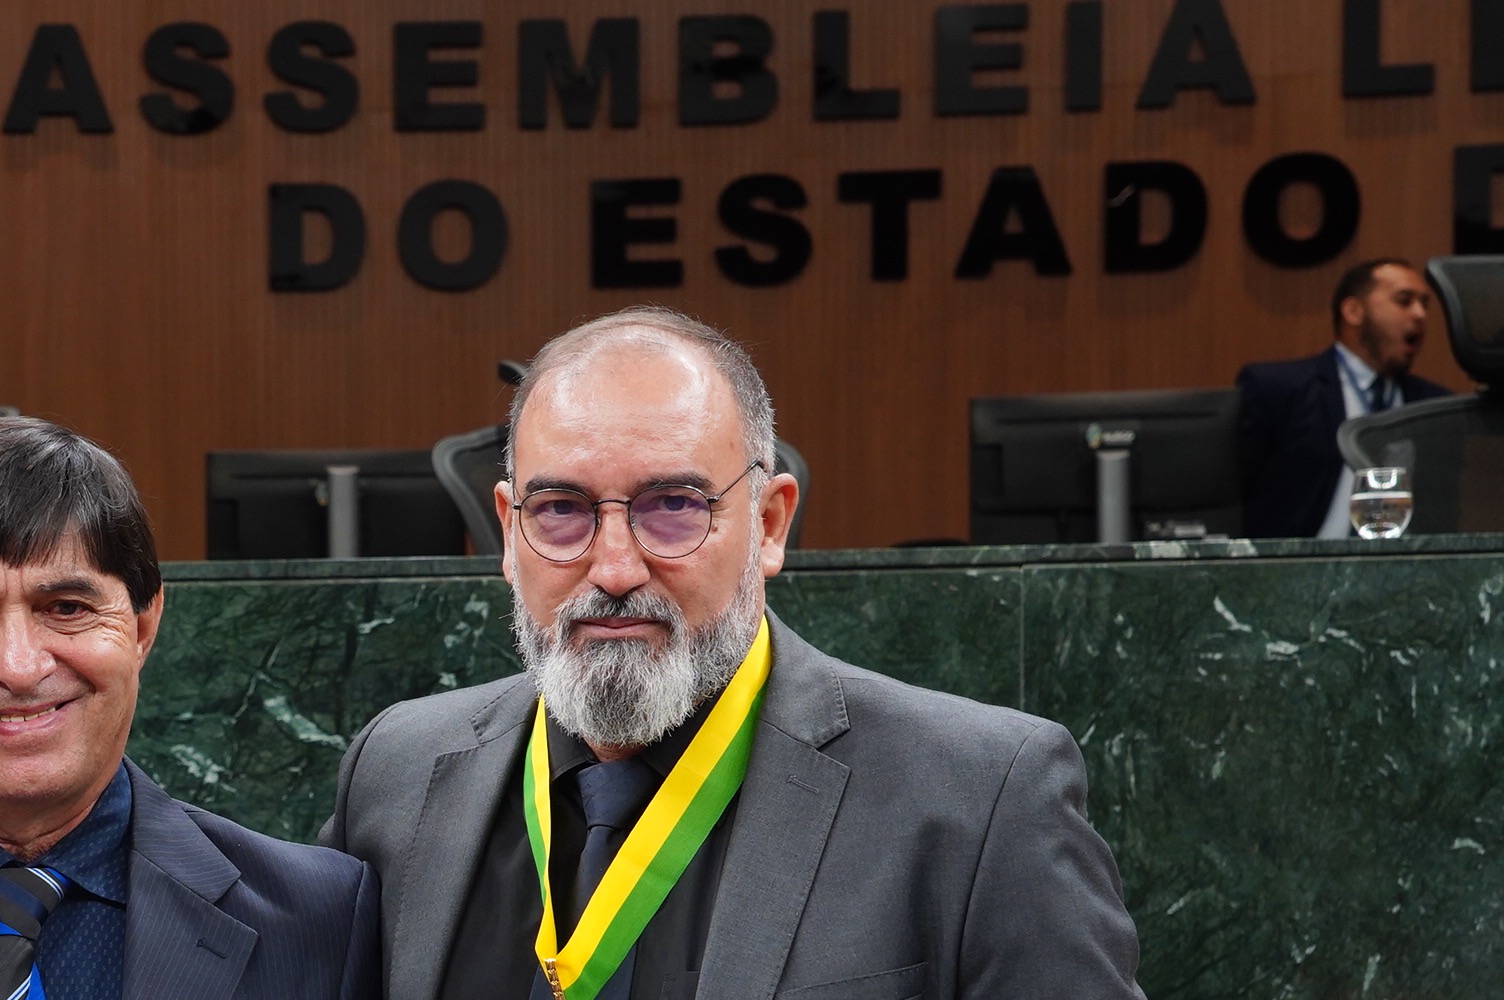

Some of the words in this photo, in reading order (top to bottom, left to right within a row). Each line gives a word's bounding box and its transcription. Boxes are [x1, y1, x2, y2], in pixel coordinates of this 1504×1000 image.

[1, 0, 1258, 135] ASSEMBLEIA
[268, 178, 510, 293] DO
[590, 151, 1363, 290] ESTADO
